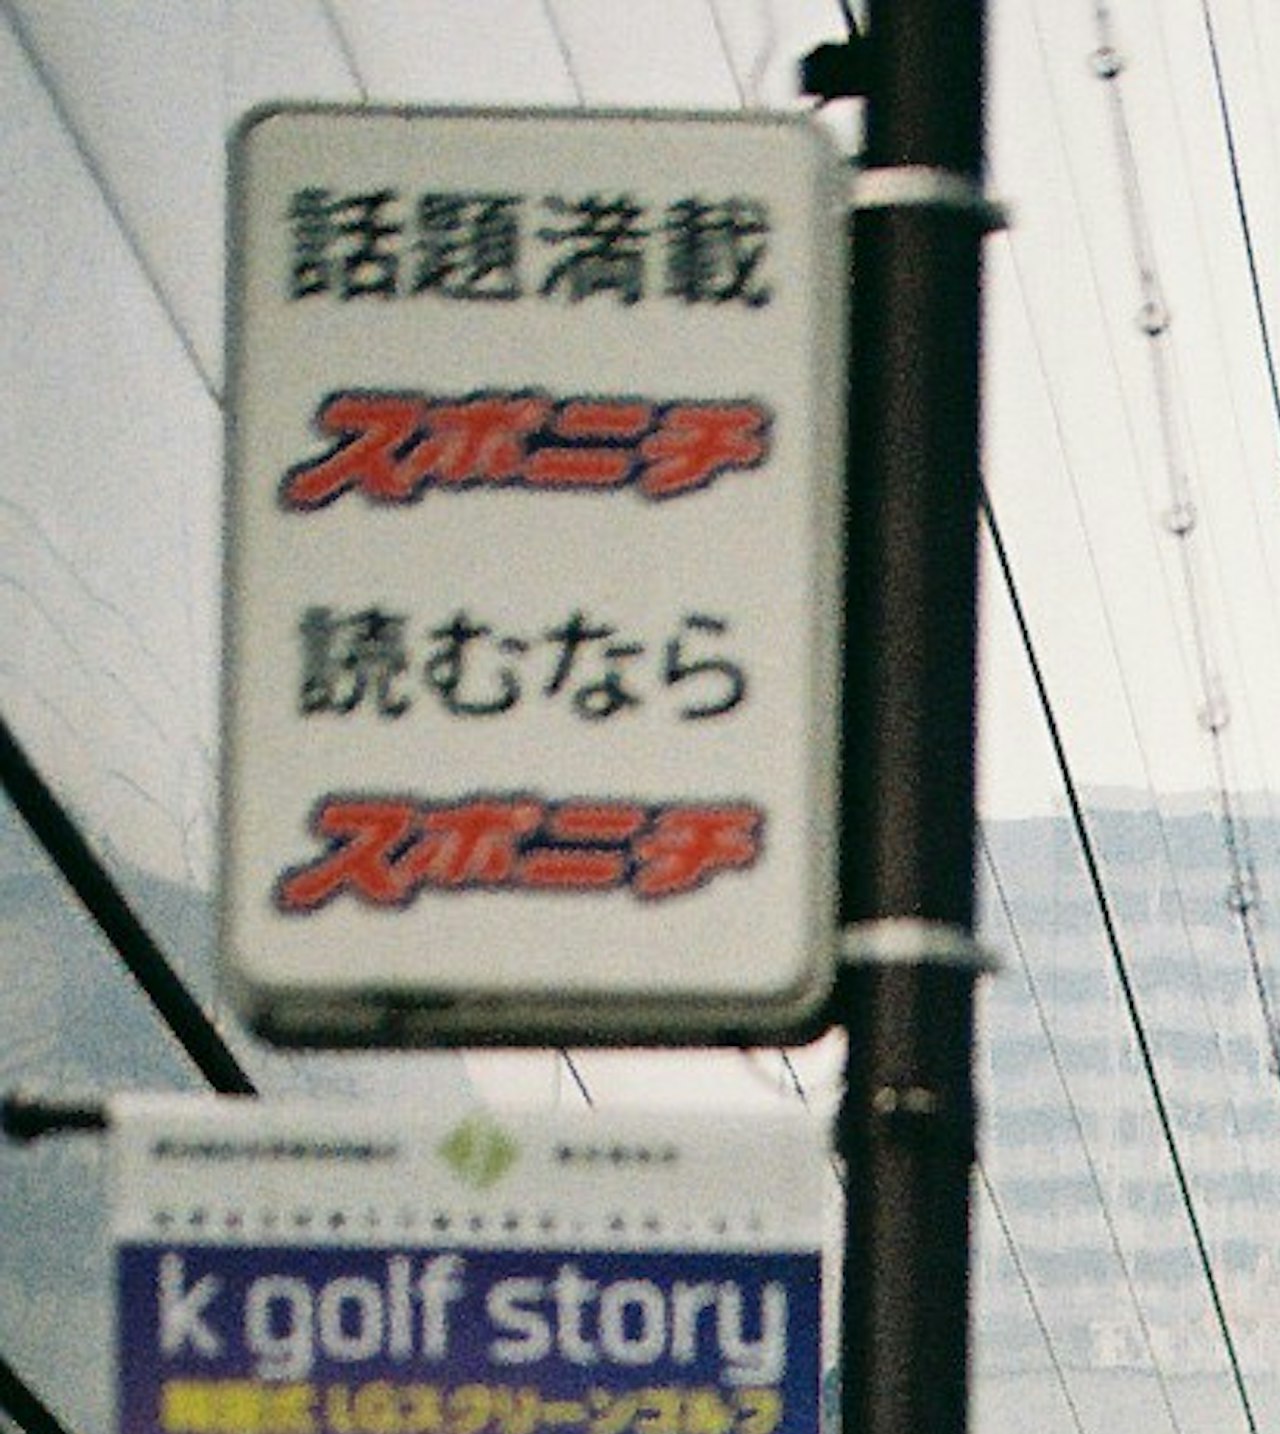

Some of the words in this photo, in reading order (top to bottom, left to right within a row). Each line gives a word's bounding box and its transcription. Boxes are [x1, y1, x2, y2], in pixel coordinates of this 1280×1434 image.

[287, 186, 773, 308] 話題満載
[277, 388, 773, 514] スポニチ
[295, 604, 748, 721] 読むなら
[275, 791, 767, 913] スポニチ
[245, 1256, 464, 1381] golf
[483, 1260, 787, 1385] story
